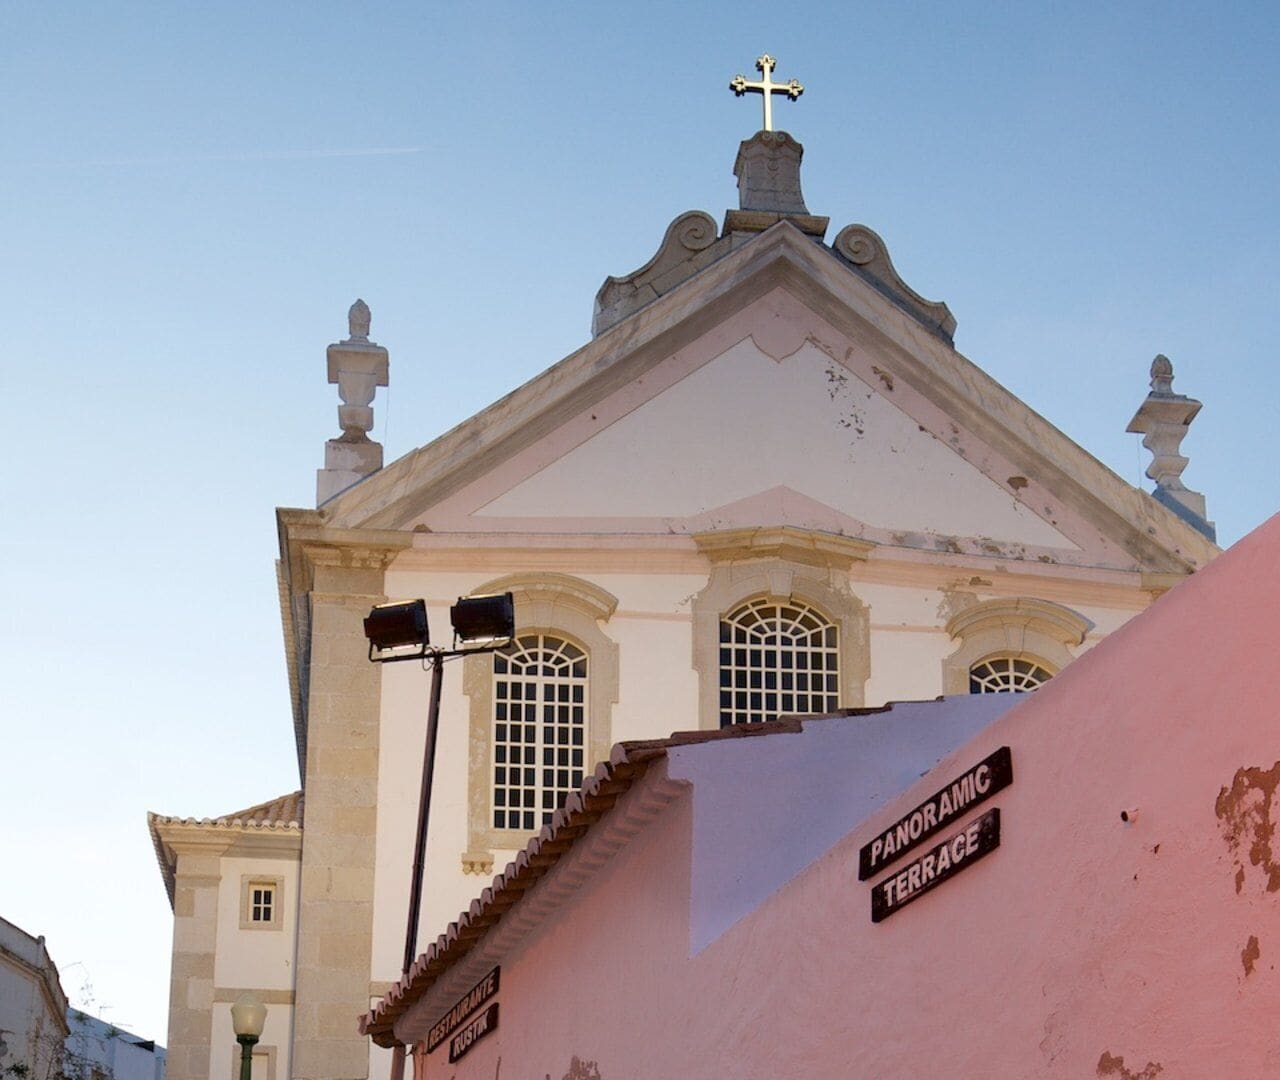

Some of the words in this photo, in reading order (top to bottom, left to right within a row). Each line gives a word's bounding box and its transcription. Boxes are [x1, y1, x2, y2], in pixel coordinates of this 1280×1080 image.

[870, 764, 991, 867] PANORAMIC
[884, 822, 980, 907] TERRACE
[428, 972, 495, 1049] RESTAURANTE
